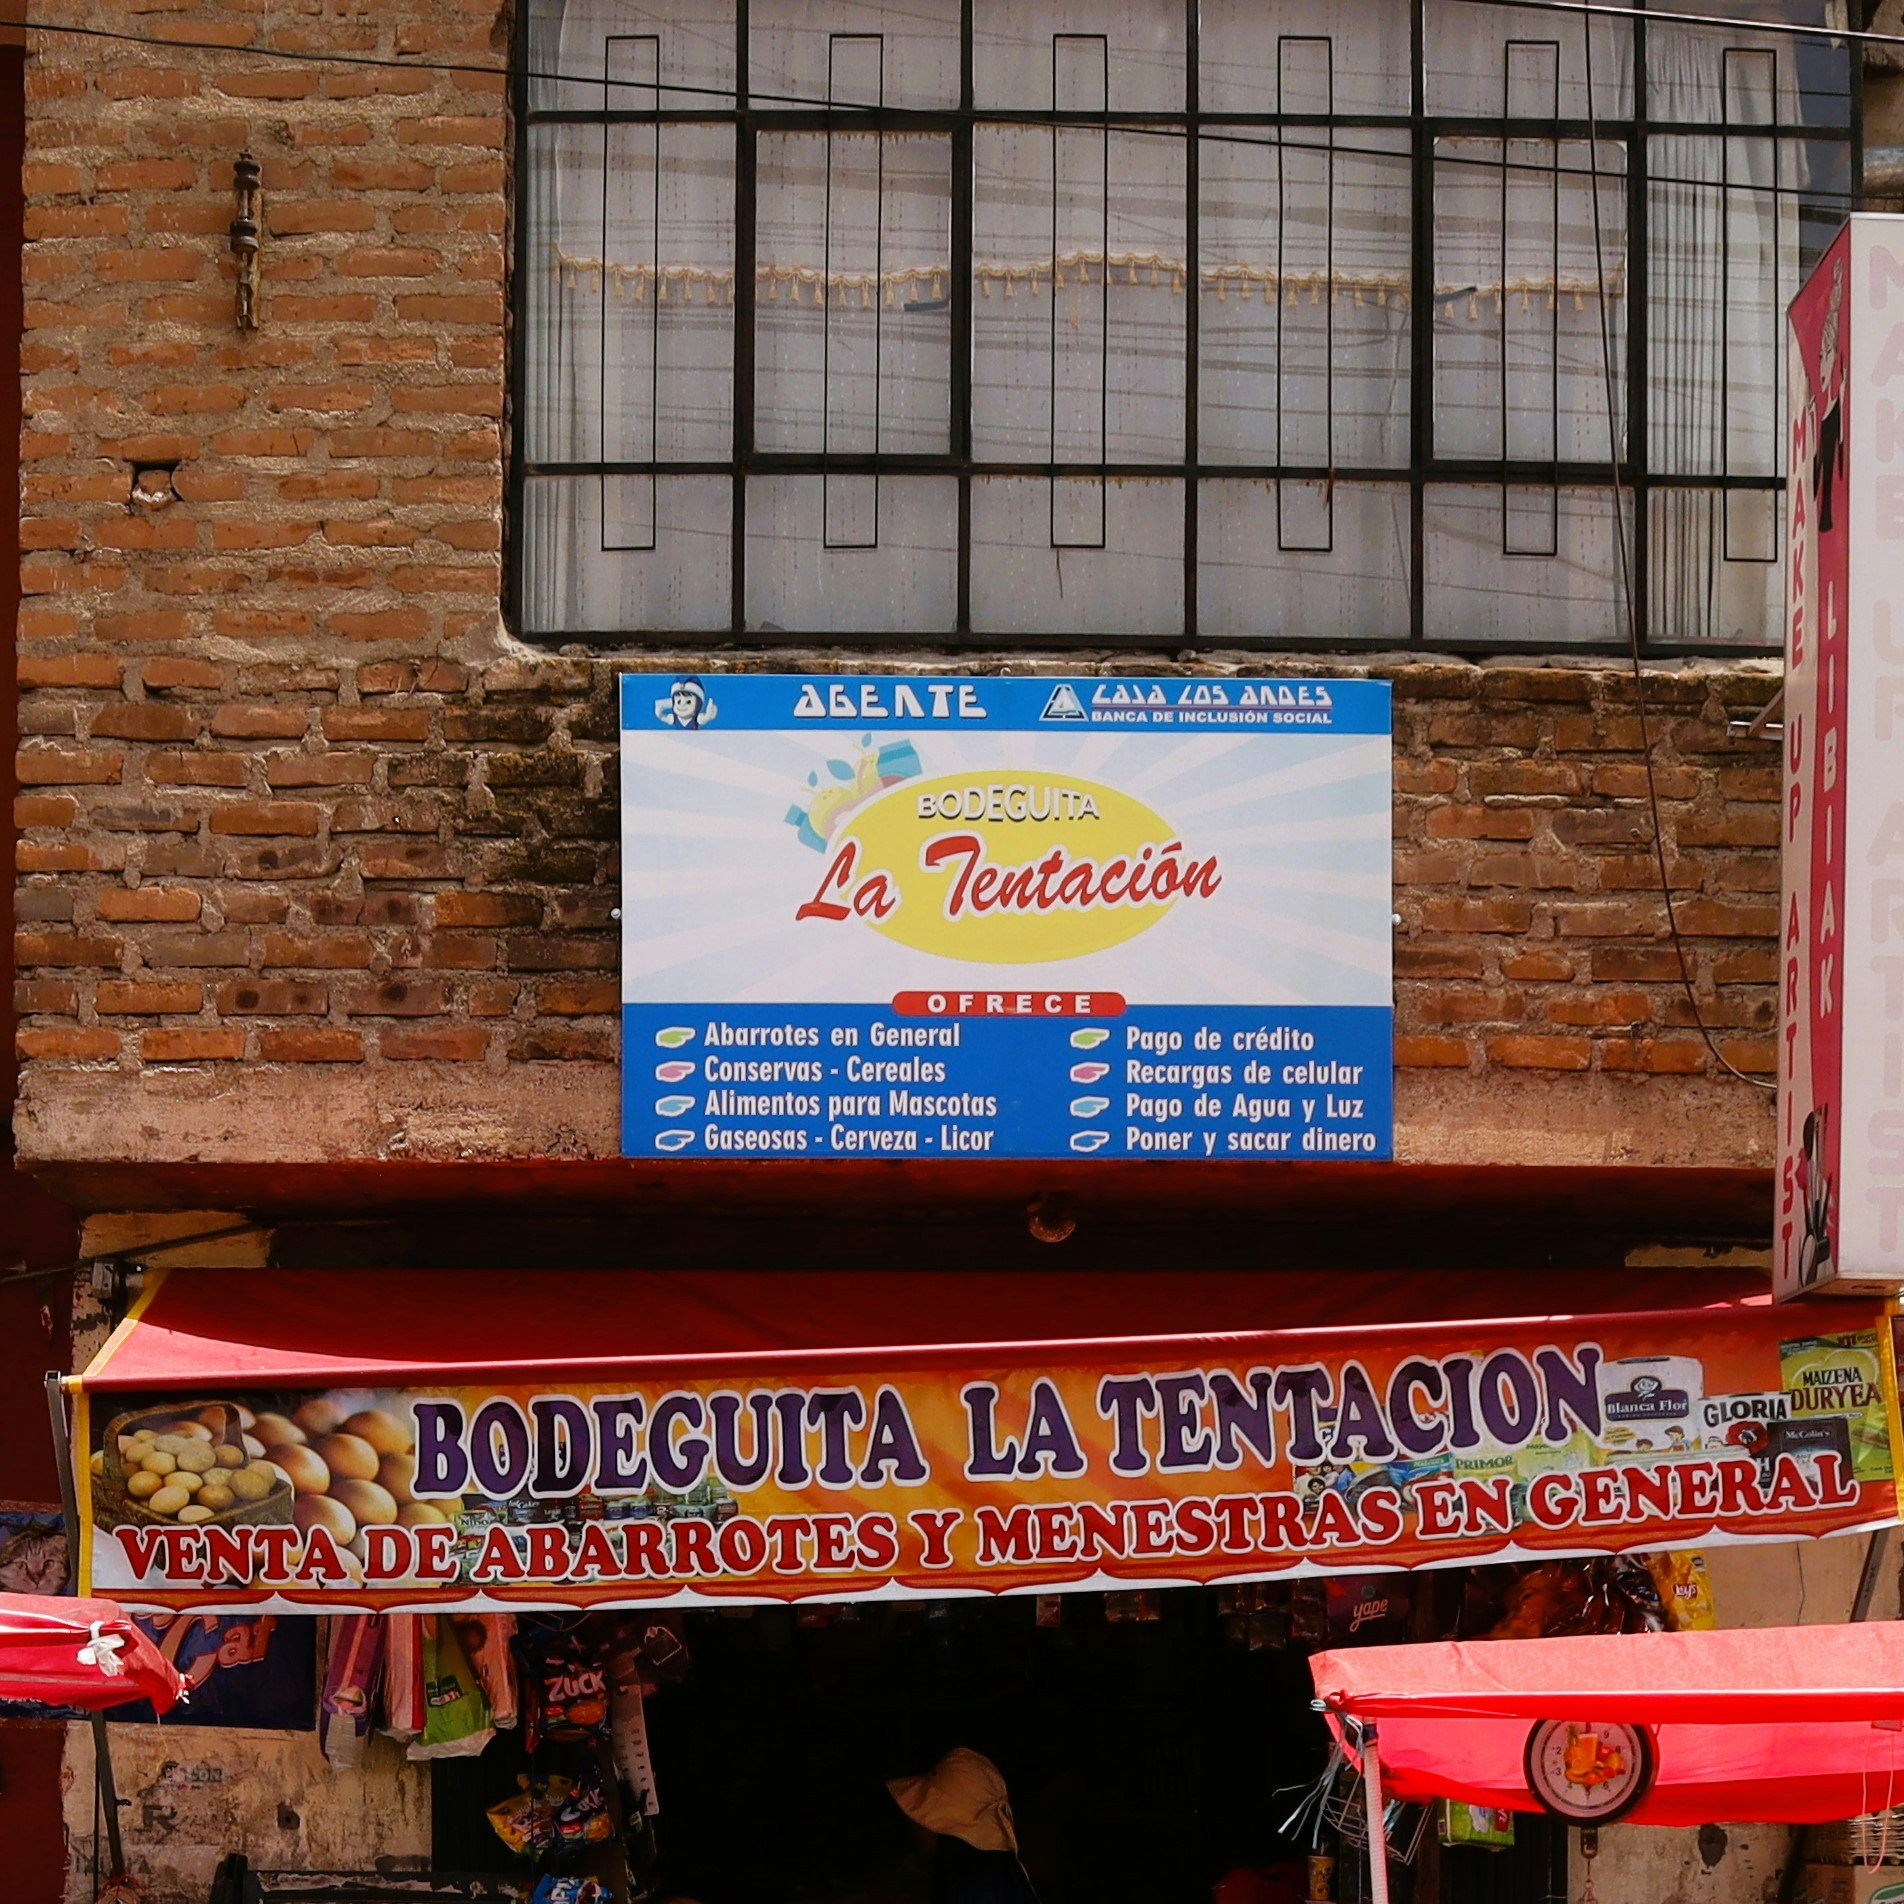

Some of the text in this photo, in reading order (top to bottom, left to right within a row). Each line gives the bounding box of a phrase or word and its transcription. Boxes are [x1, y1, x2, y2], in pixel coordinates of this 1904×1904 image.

[792, 684, 987, 719] AGENTE
[1092, 684, 1333, 707] CAJA LOS ANDES
[1091, 710, 1333, 724] BANCA DE INCLUSIÓN SOCIAL
[917, 784, 1100, 822] BODEGUITA
[1782, 419, 1806, 1279] MAKE UP ARTIST
[795, 836, 1223, 922] La Tentación
[927, 995, 1092, 1014] OFRECE
[704, 1022, 960, 1048] Abarrotes en General
[1126, 1024, 1315, 1056] Pago de crédito
[704, 1057, 823, 1082] Conservas
[845, 1057, 946, 1083] Cereales
[1126, 1061, 1363, 1090] Recargas de celular
[704, 1091, 997, 1123] Alimentos para Mascotas
[1126, 1094, 1363, 1125] Pago de Agua y Luz
[704, 1125, 809, 1151] Gaseosas
[830, 1126, 917, 1151] Cerveza
[940, 1127, 994, 1151] Licor
[1126, 1128, 1376, 1157] Poner y sacar dinero
[1802, 1368, 1862, 1385] MAIZENA
[1607, 1402, 1654, 1414] Blanca
[1659, 1399, 1687, 1411] Flor
[1792, 1382, 1883, 1410] DURYEA
[411, 1343, 1605, 1498] BODEGUITA LA TENTACION
[1704, 1399, 1787, 1428] GLORIA
[1785, 1430, 1830, 1440] McColin's
[1456, 1455, 1514, 1470] PRIMOR
[115, 1451, 1861, 1586] VENTA DE ABARROTES Y MENESTRAS EN GENERAL
[1350, 1600, 1387, 1632] yape
